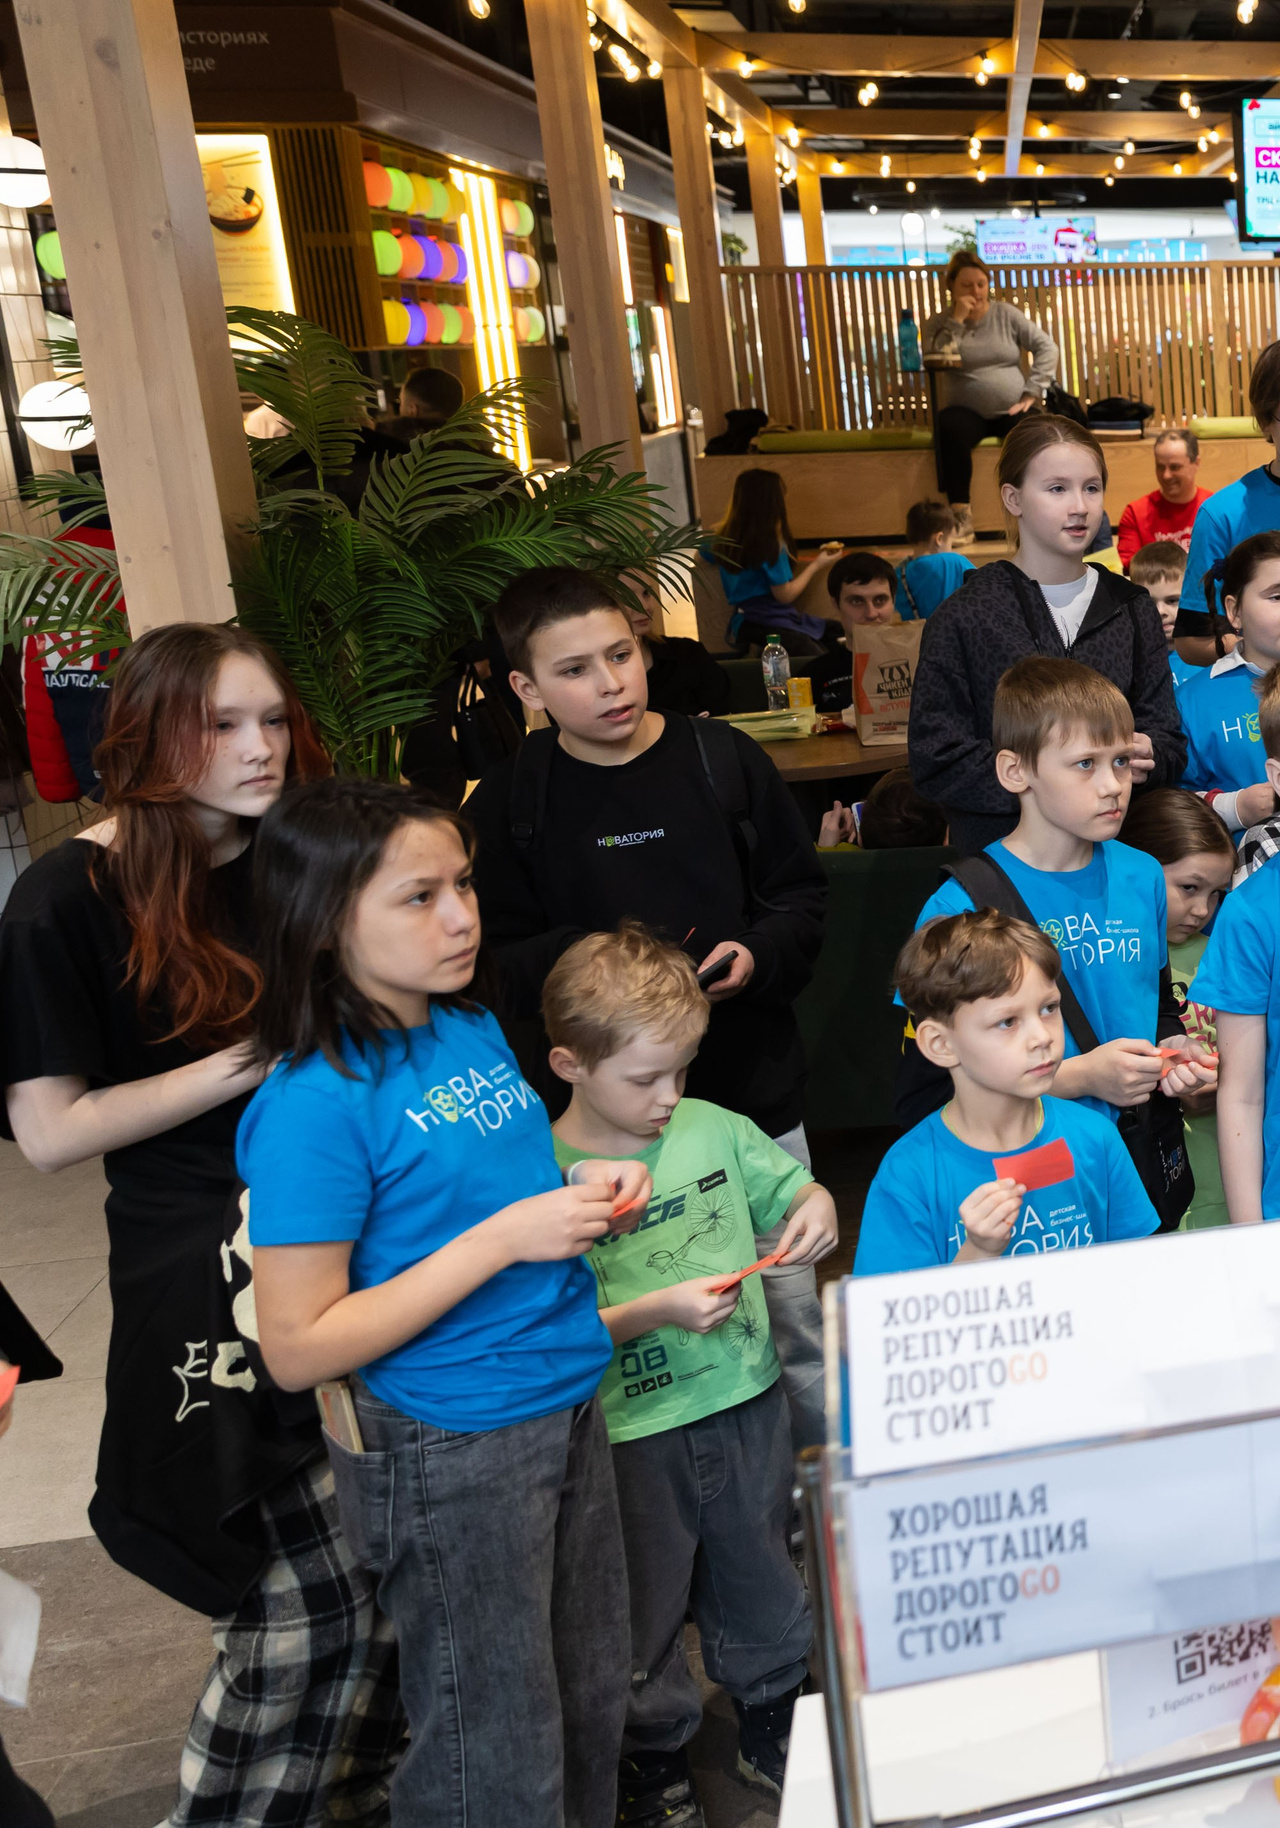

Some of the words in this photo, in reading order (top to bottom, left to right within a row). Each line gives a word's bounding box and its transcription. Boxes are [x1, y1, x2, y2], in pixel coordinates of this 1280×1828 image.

[1256, 172, 1279, 184] НА
[463, 1080, 541, 1136] ТОРИ
[1050, 1205, 1076, 1217] детская
[884, 1281, 1033, 1327] ХОРОШАЯ
[884, 1311, 1073, 1364] РЕПУТАЦИЯ
[887, 1399, 994, 1442] СТОИТ
[889, 1483, 1048, 1540] ХОРОШАЯ
[890, 1518, 1088, 1582] РЕПУТАЦИЯ
[898, 1612, 1007, 1660] СТОИТ
[1163, 1692, 1205, 1713] Брось
[1208, 1673, 1248, 1696] билет
